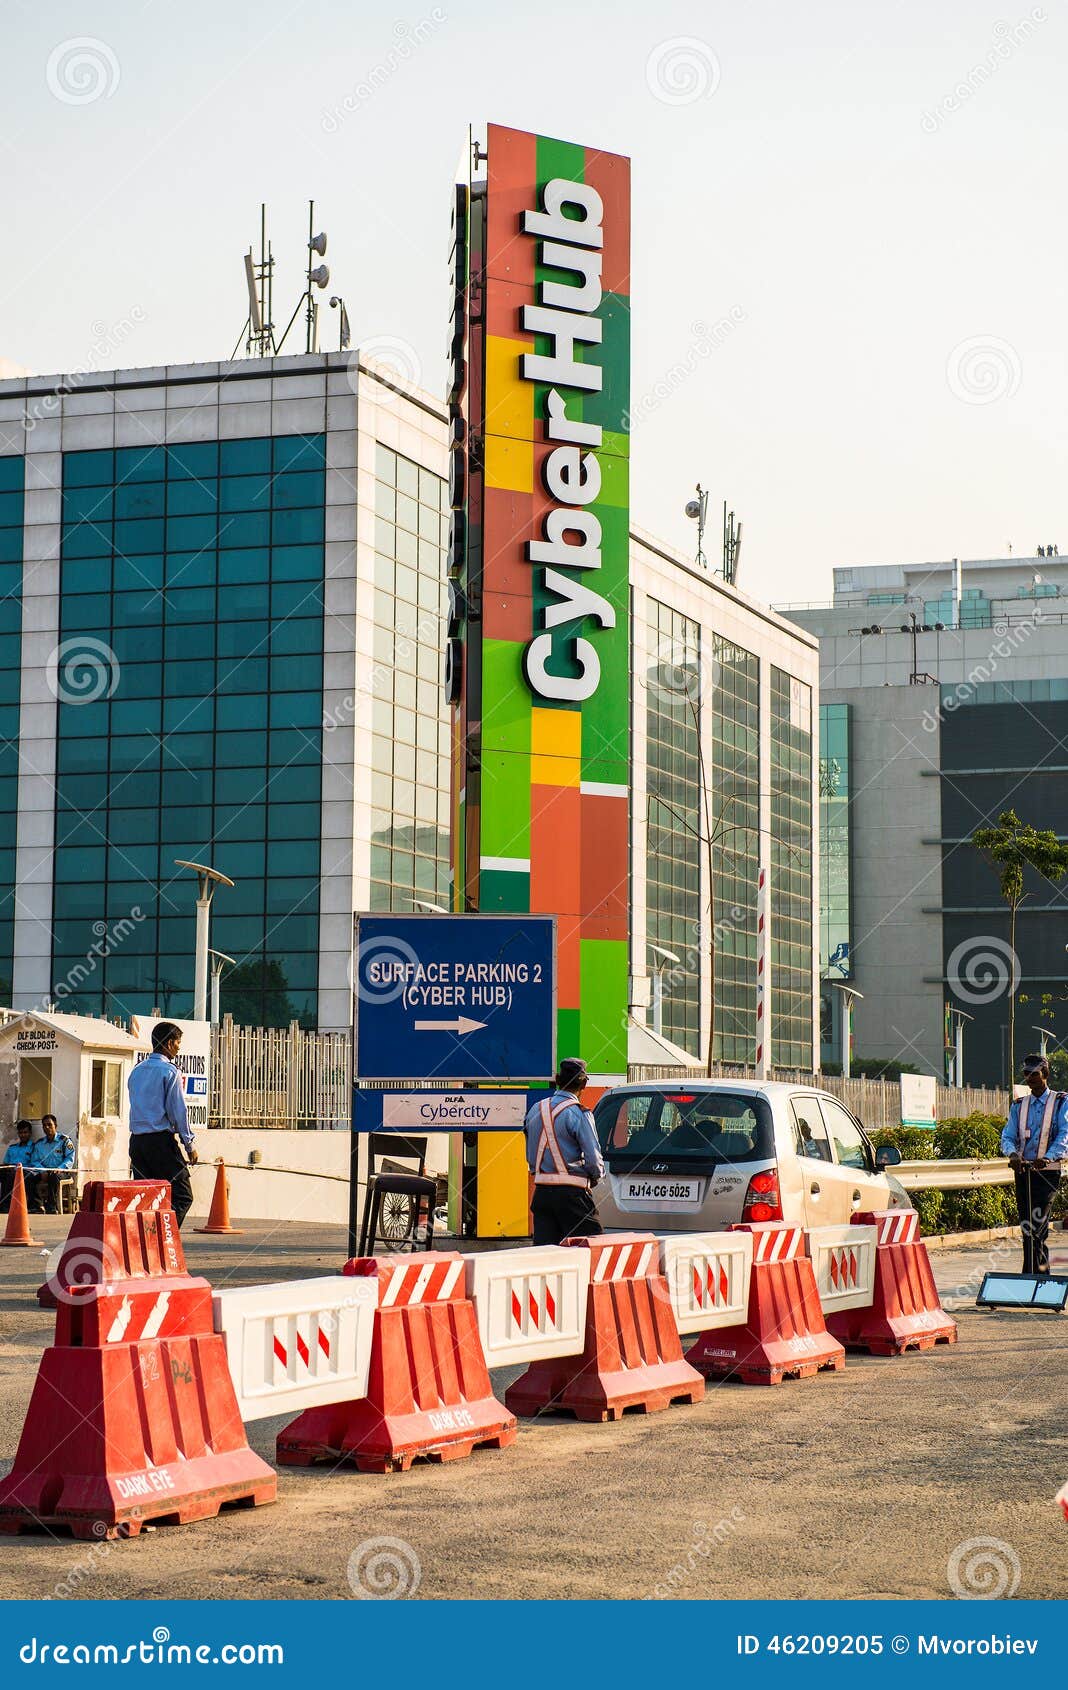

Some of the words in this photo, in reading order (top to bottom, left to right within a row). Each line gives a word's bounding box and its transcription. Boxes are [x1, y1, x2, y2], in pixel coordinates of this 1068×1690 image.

[521, 177, 615, 700] CyberHub
[370, 962, 449, 983] SURFACE
[454, 963, 529, 983] PARKING
[533, 963, 542, 983] 2
[402, 985, 466, 1011] (CYBER
[471, 985, 513, 1011] HUB)
[420, 1103, 491, 1121] Cybercity
[163, 1213, 174, 1244] DARK
[168, 1247, 178, 1268] EYE
[115, 1474, 154, 1498] DARK
[148, 1469, 175, 1492] EYE
